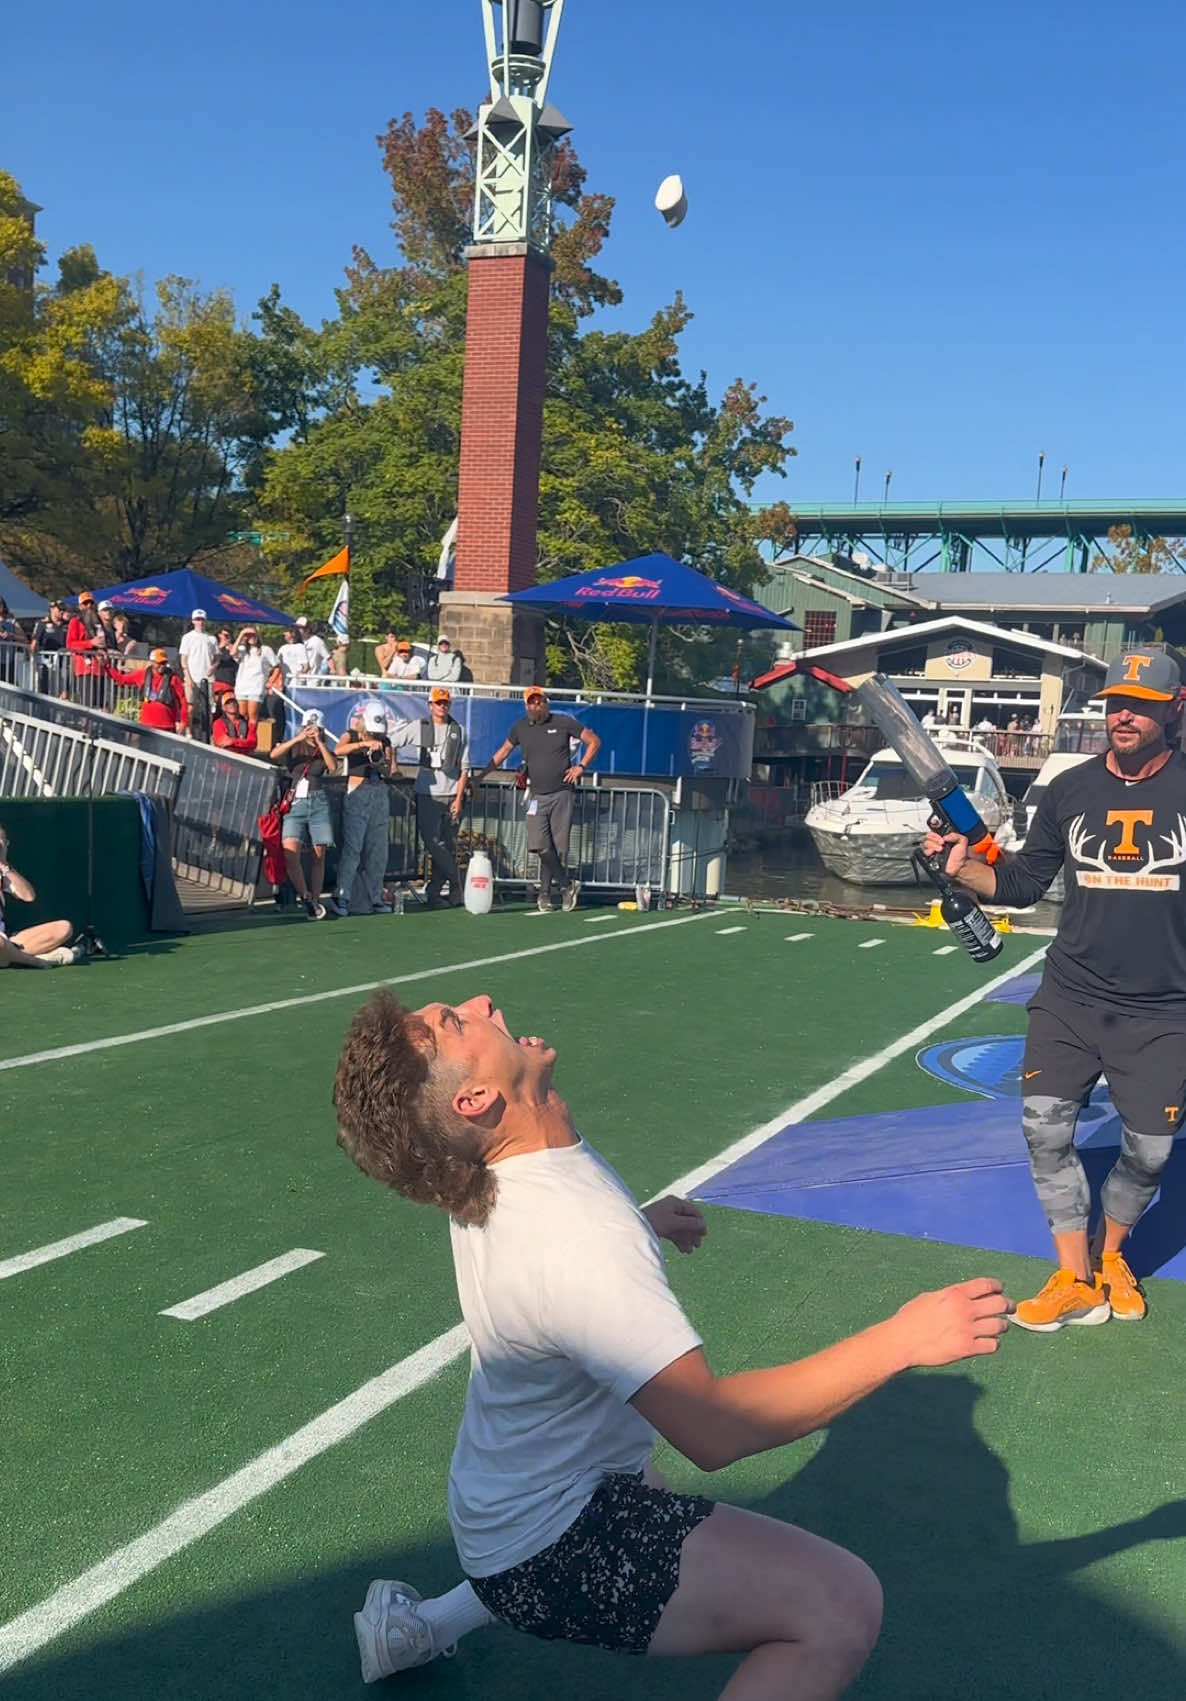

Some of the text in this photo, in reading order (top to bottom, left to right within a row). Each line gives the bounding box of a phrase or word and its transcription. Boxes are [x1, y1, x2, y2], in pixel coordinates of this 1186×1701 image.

[576, 586, 661, 599] Red Bull
[1121, 655, 1151, 681] T
[1106, 810, 1154, 854] T
[1083, 873, 1171, 888] ON THE HUNT
[1164, 1106, 1179, 1122] T
